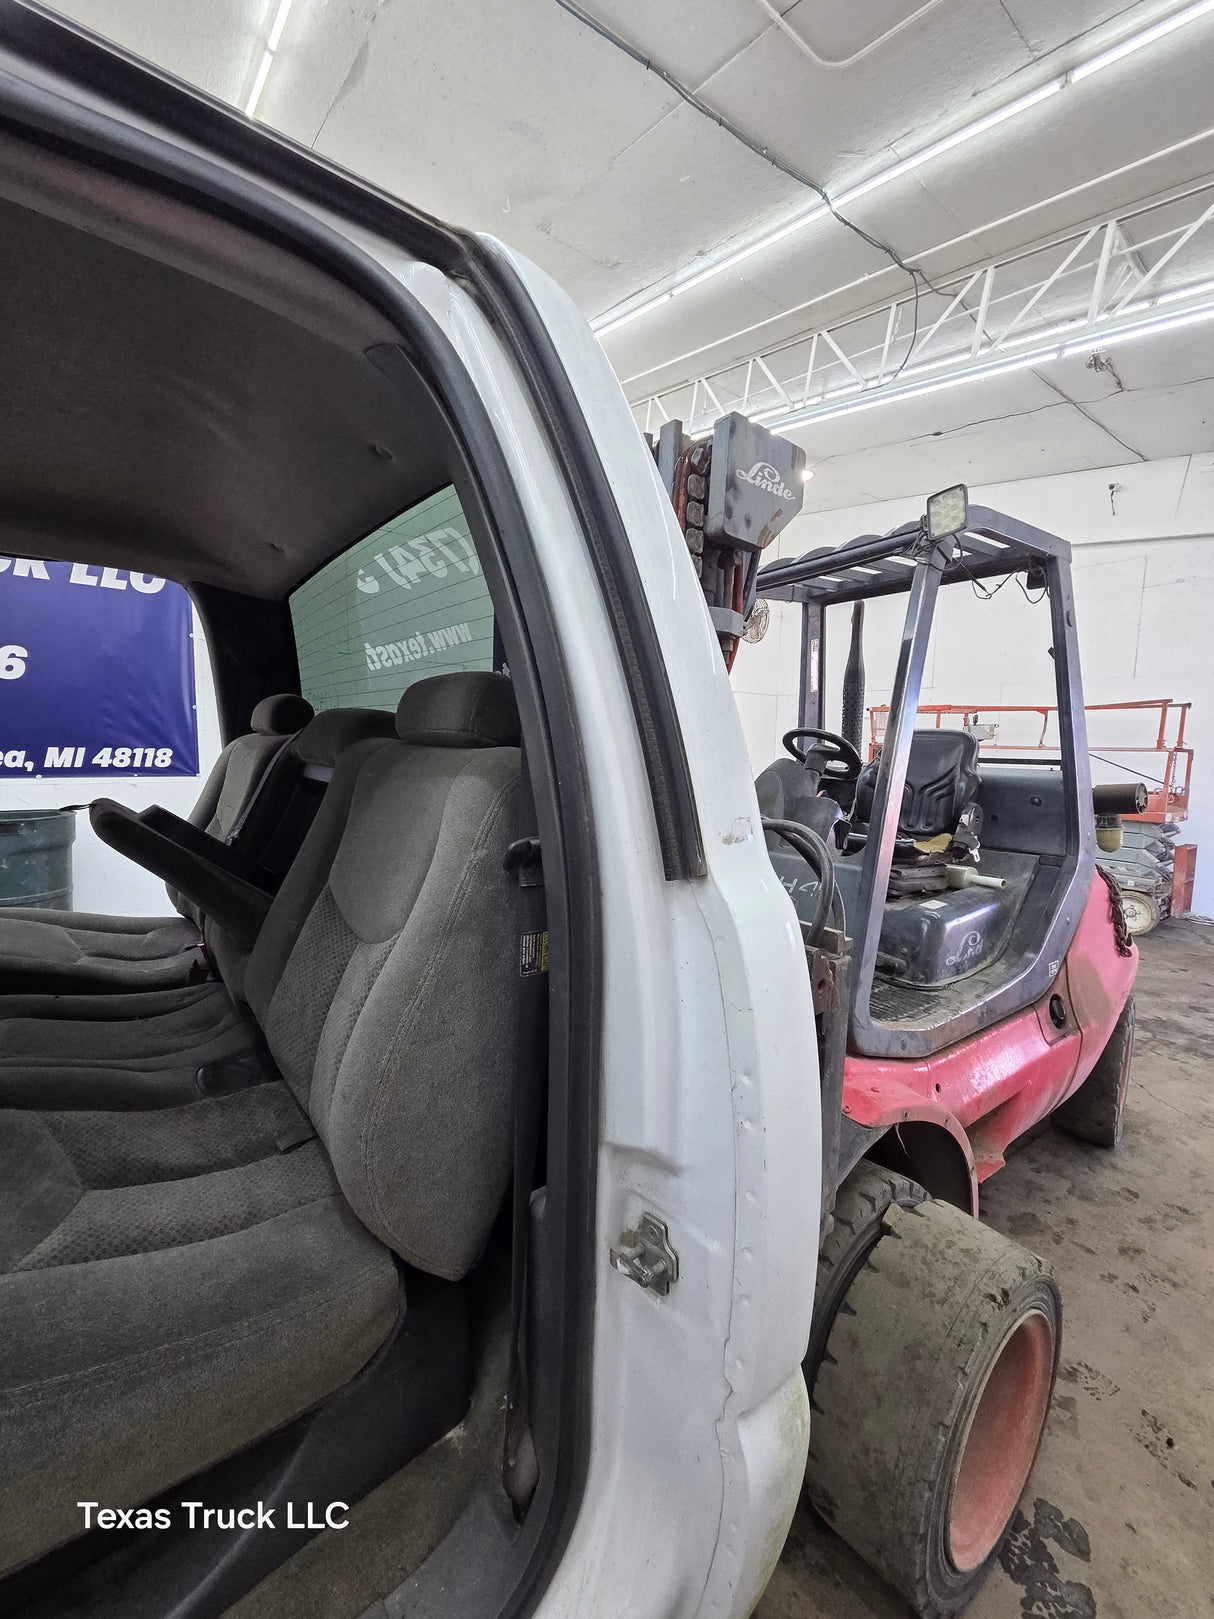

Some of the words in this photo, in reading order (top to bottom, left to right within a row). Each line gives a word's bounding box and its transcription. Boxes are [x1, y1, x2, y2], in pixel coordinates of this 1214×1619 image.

[736, 462, 796, 500] Linde
[43, 747, 86, 768] MI
[92, 747, 173, 768] 48118
